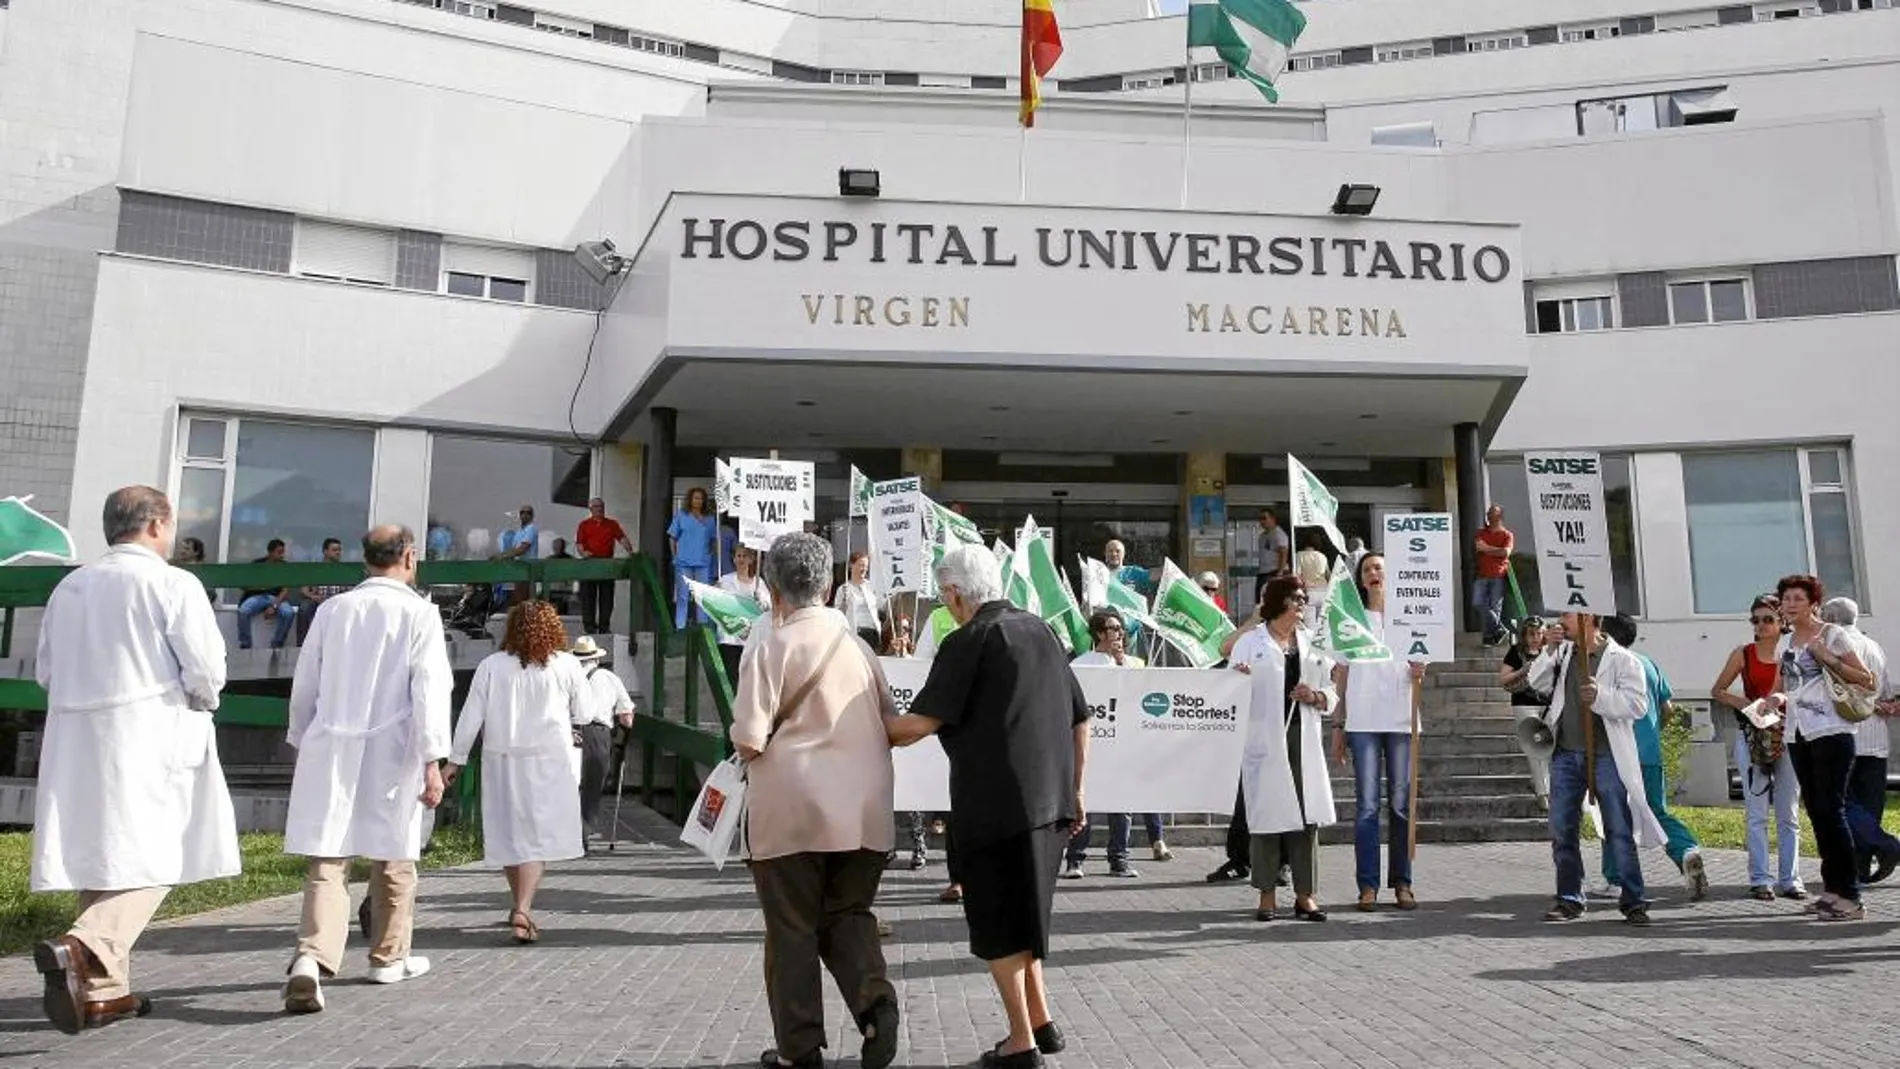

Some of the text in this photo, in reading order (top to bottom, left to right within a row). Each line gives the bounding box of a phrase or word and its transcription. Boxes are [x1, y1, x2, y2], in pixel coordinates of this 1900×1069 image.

[680, 217, 1512, 284] HOSPITAL UNIVERSITARIO
[800, 293, 1408, 339] VIRGEN MACARENA
[1528, 458, 1597, 475] SATSE
[875, 480, 919, 497] SATSE
[757, 500, 786, 524] YA!!
[1387, 517, 1450, 532] SATSE
[1554, 520, 1586, 545] YA!!
[1398, 570, 1441, 581] CONTRATOS
[1396, 587, 1442, 598] EVENTUALES
[1172, 693, 1204, 708] Stop
[1172, 705, 1236, 721] recortes!
